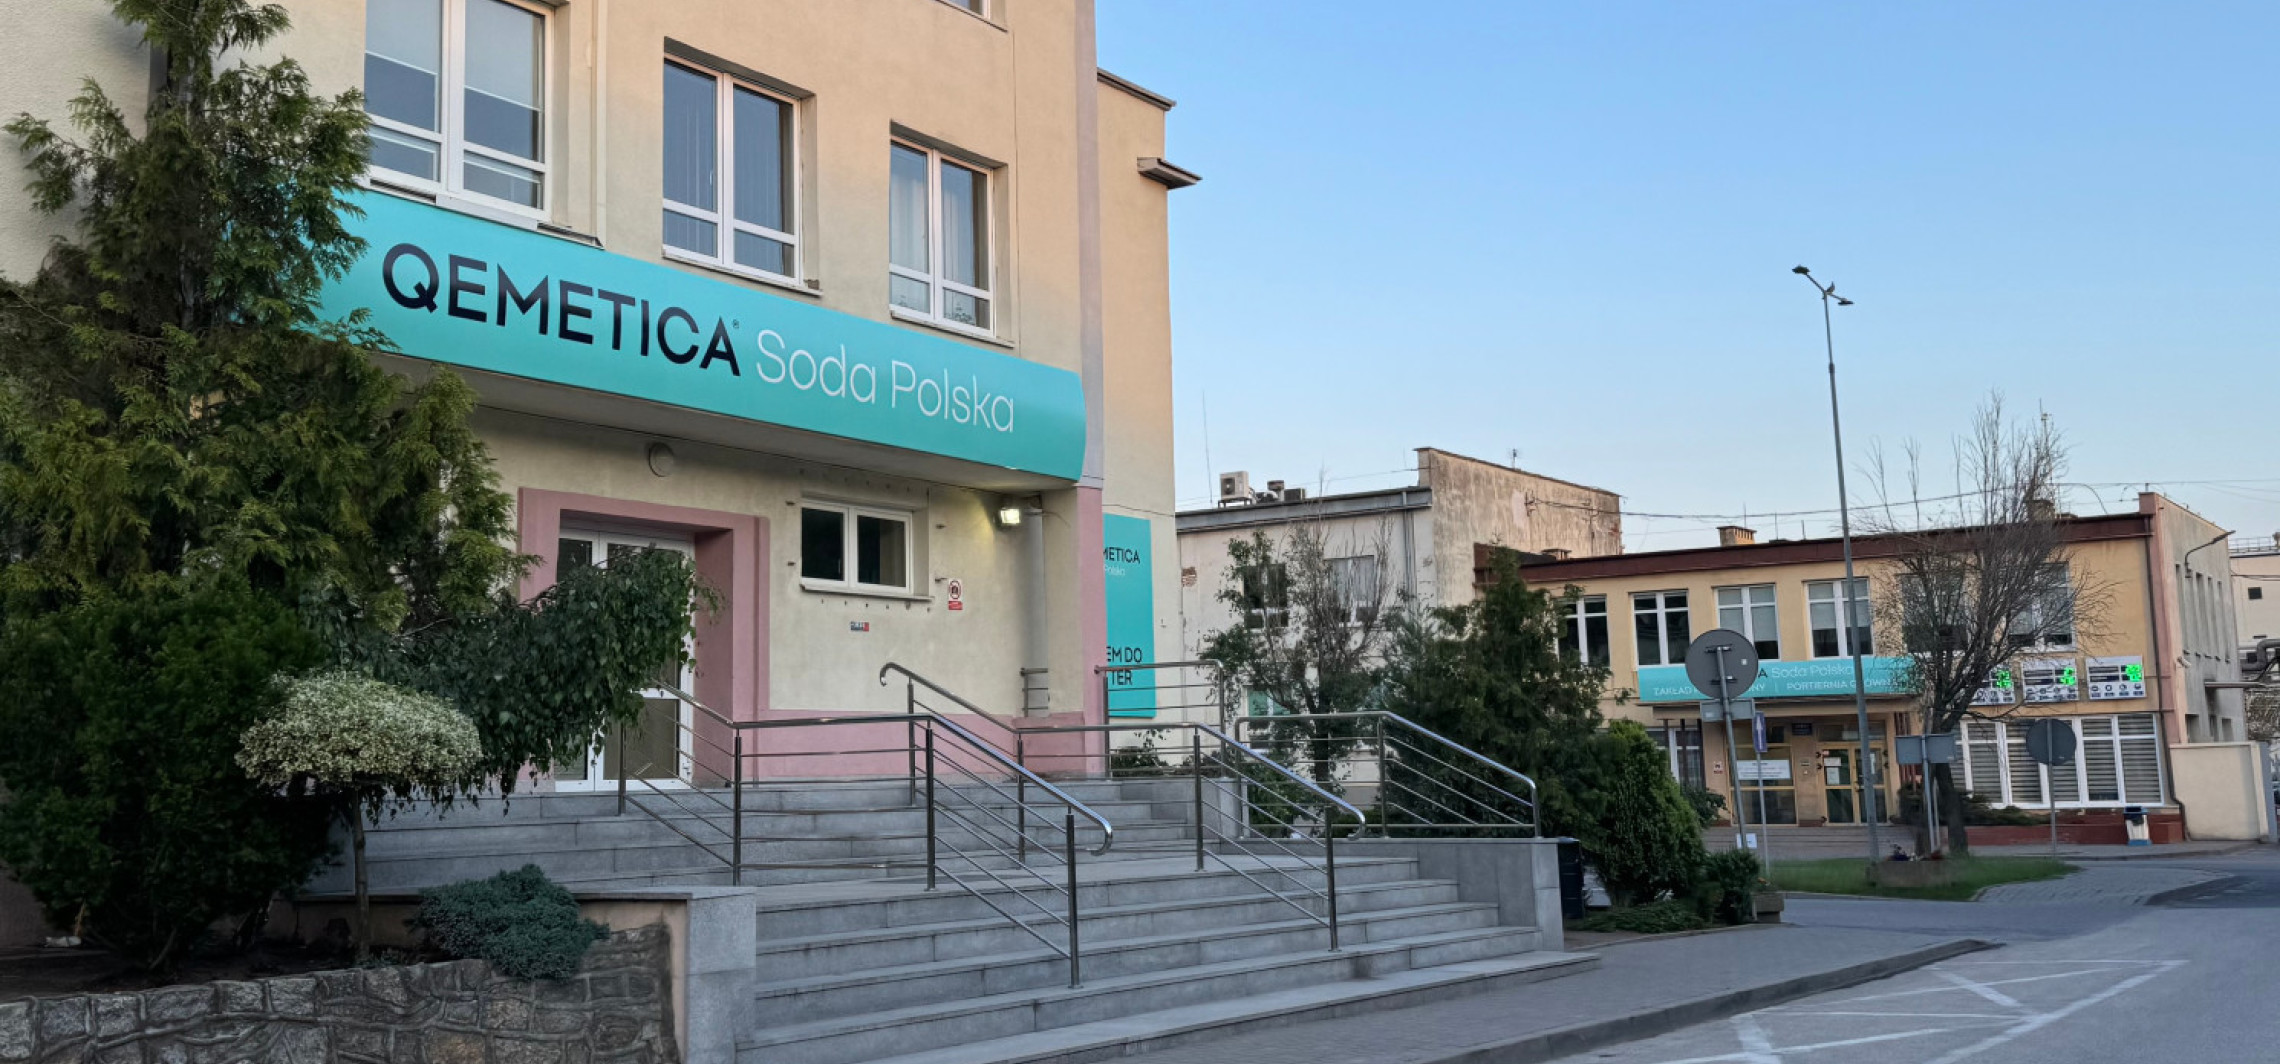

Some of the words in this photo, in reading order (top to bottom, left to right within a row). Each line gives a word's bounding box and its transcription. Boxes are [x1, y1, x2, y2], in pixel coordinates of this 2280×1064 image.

[756, 329, 876, 404] Soda
[891, 360, 1014, 433] Polska
[1103, 546, 1141, 564] METICA
[1106, 646, 1122, 663] EM
[1124, 646, 1143, 663] DO
[1109, 668, 1133, 686] TER
[1771, 667, 1807, 679] Soda
[1786, 680, 1848, 691] PORTIERNIA
